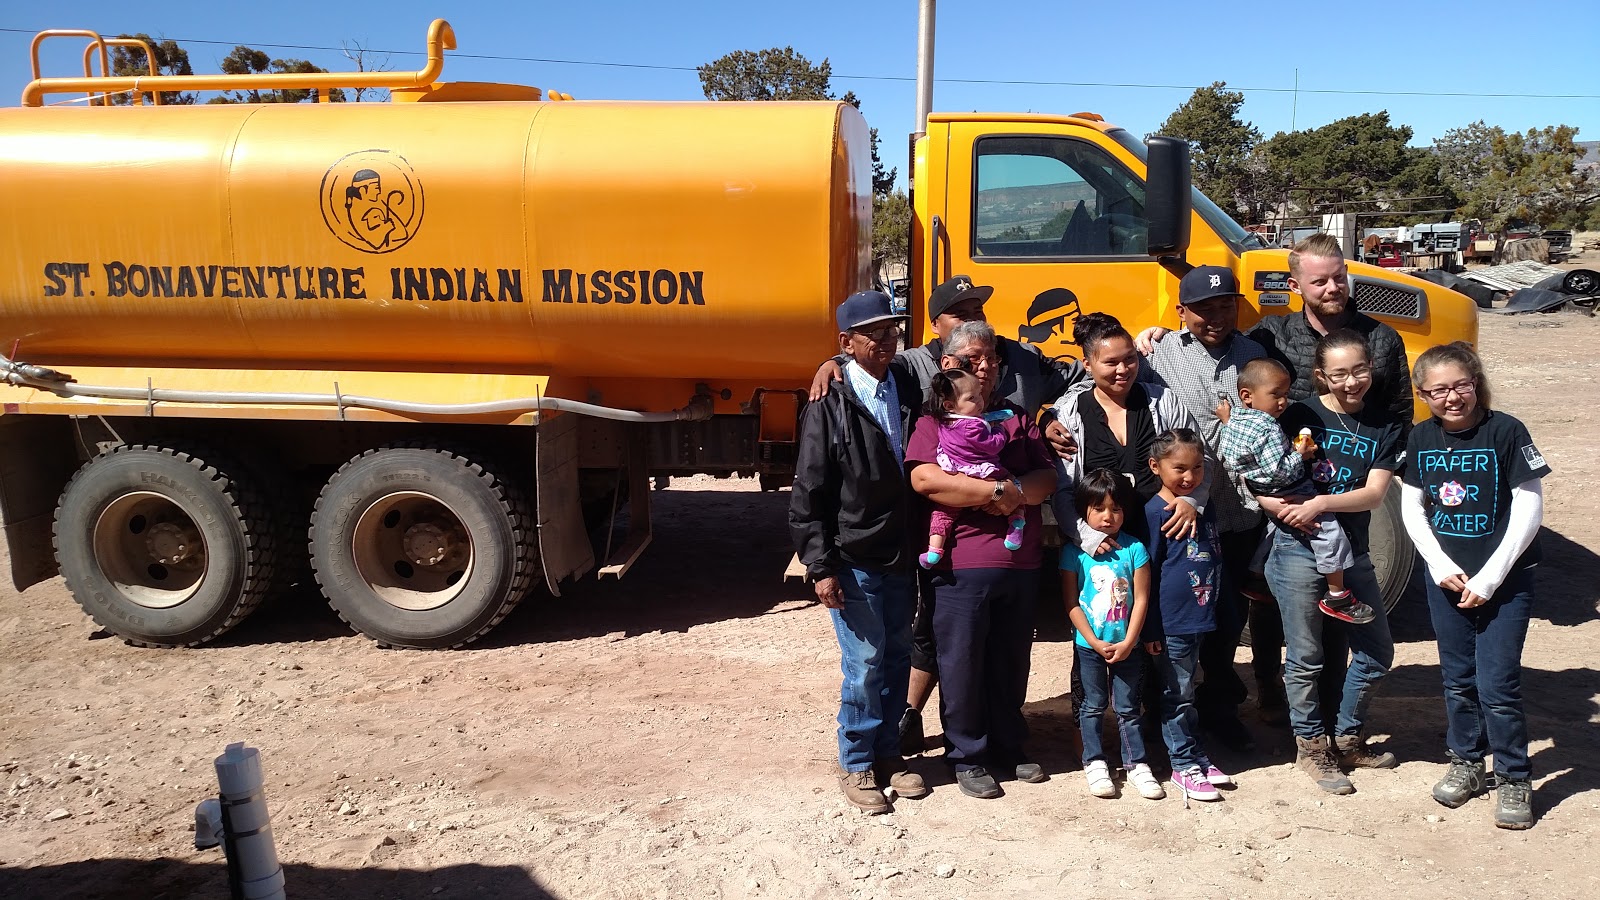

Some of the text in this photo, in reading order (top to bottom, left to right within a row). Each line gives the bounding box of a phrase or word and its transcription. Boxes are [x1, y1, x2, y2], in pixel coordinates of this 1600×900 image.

[44, 261, 706, 305] ST. BONAVENTURE INDIAN MISSION
[1313, 432, 1368, 459] APER
[1425, 454, 1489, 472] PAPER
[1429, 484, 1480, 502] FR
